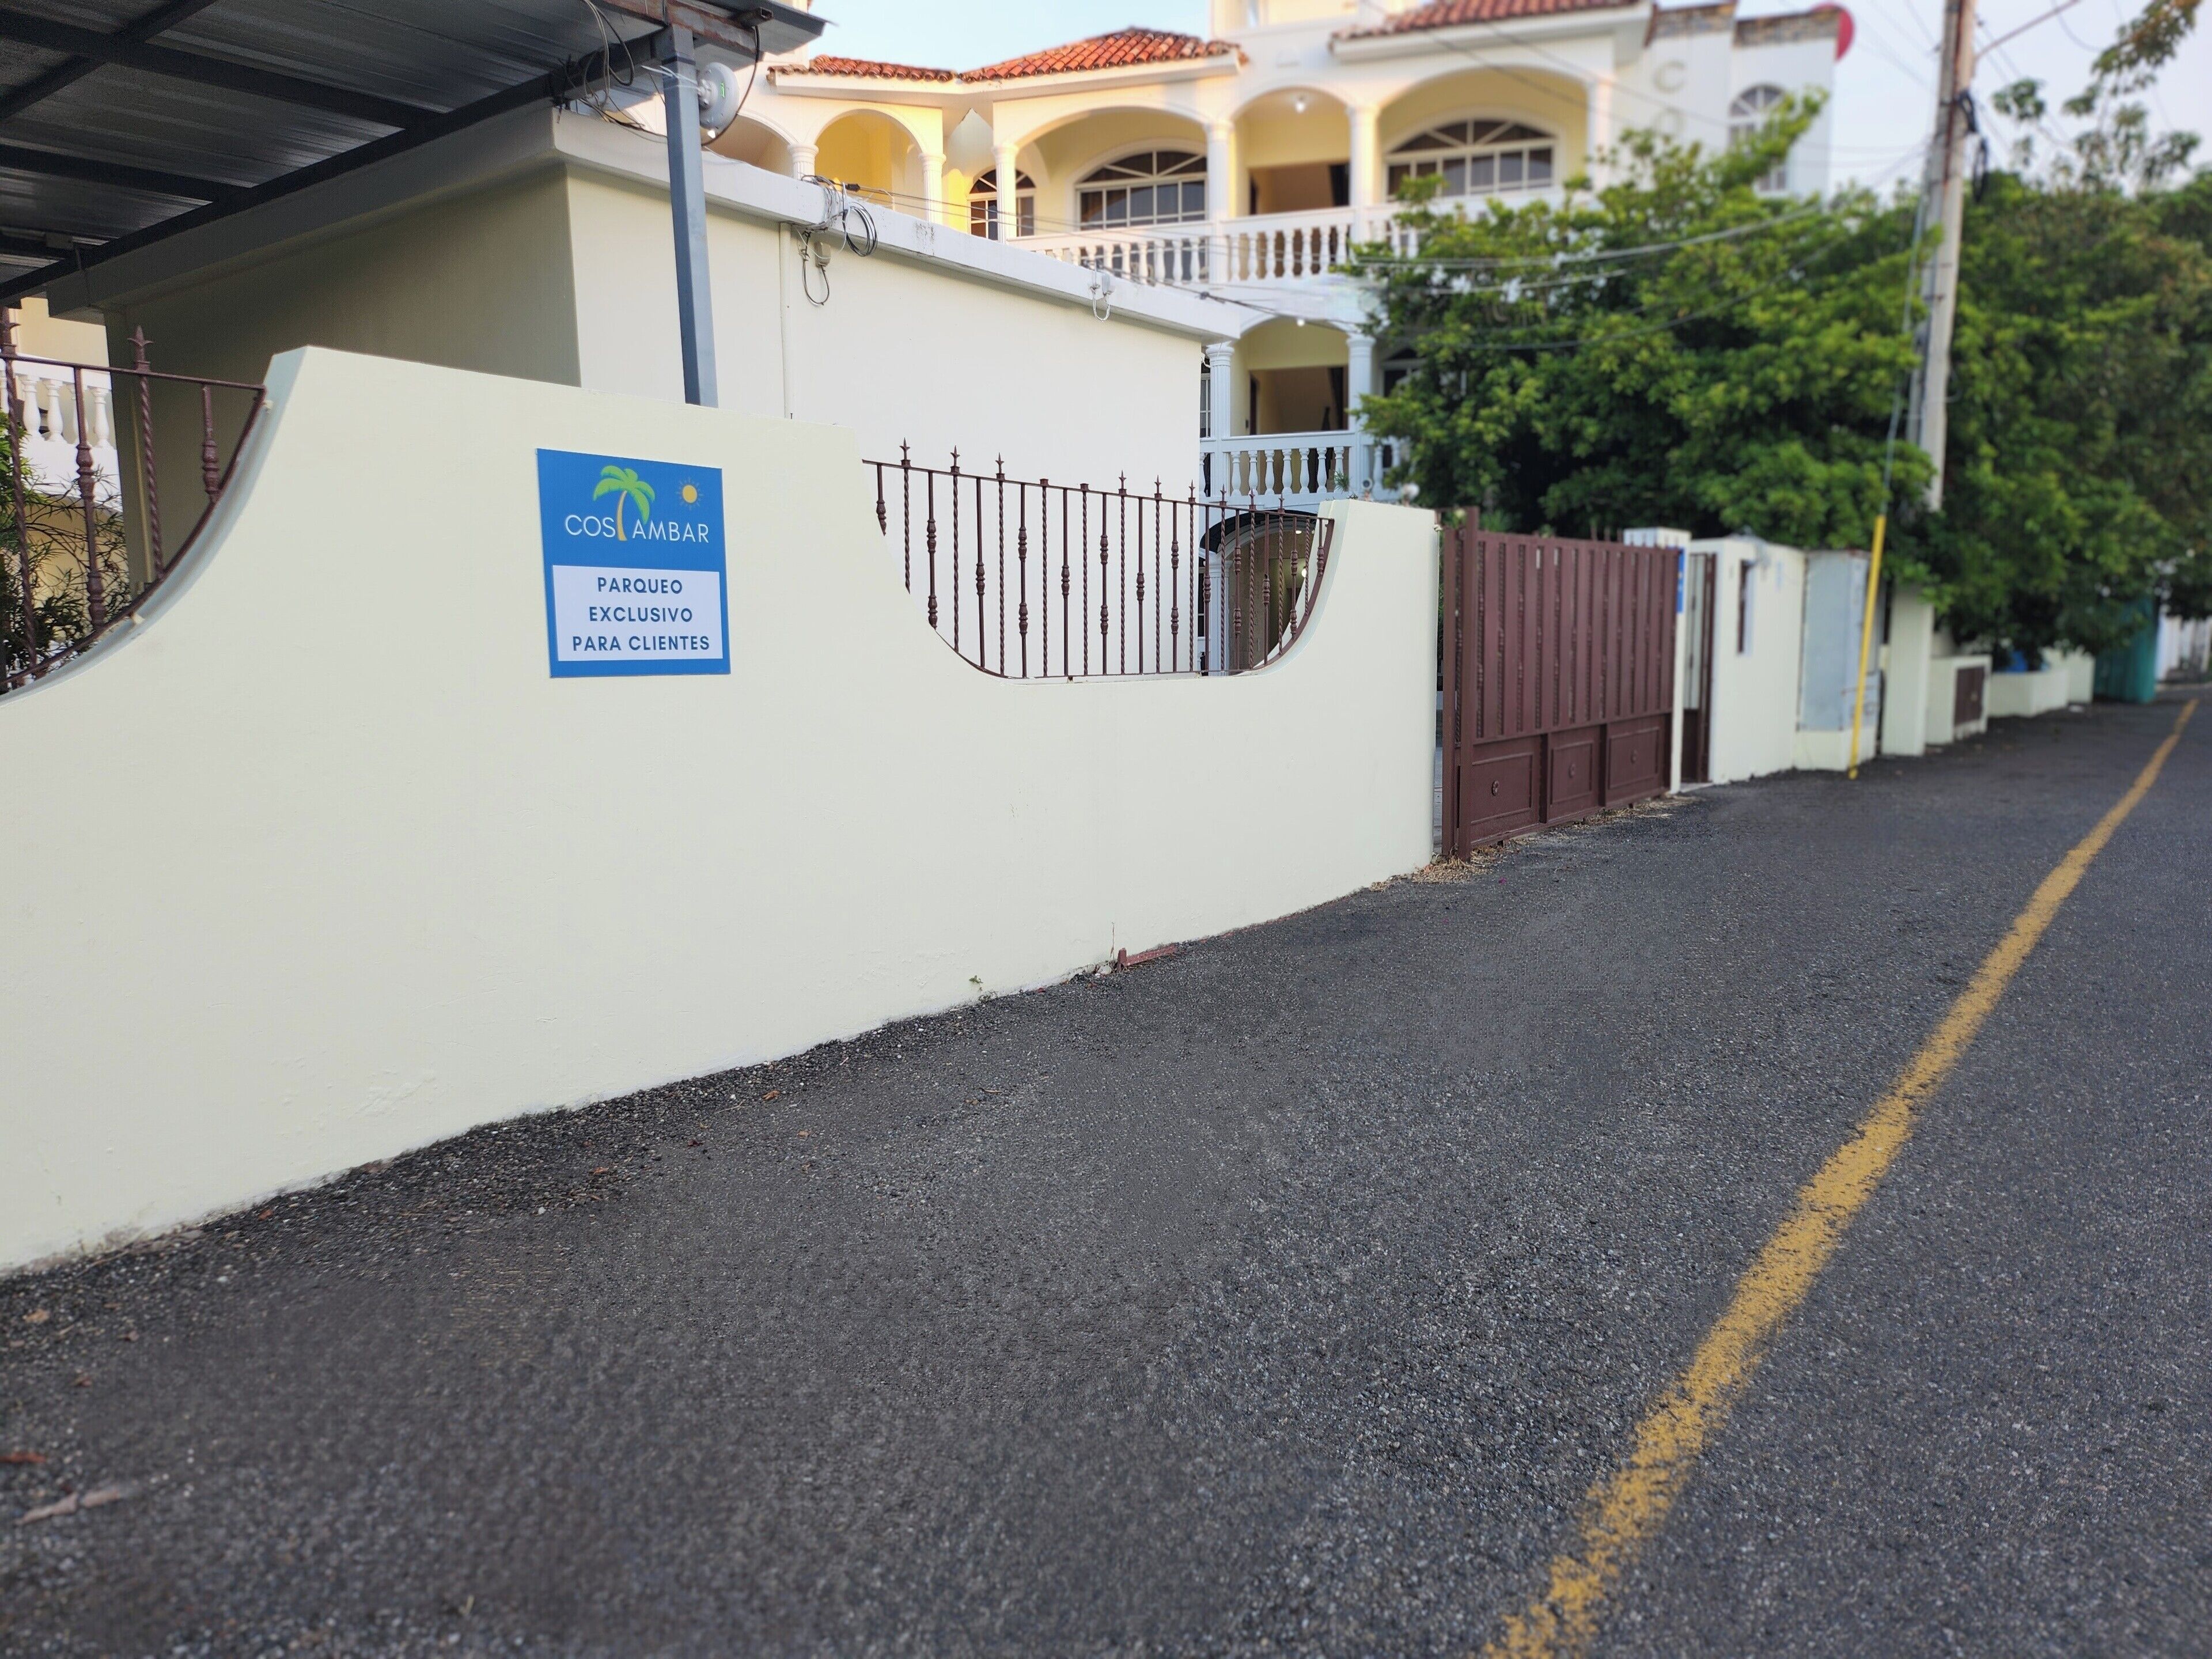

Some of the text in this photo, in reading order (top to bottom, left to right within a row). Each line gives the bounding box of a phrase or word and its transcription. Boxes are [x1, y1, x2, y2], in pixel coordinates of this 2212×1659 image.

[597, 577, 683, 594] PARQUEO
[589, 607, 692, 622] EXCLUSIVO
[573, 635, 710, 651] PARA CLIENTES
